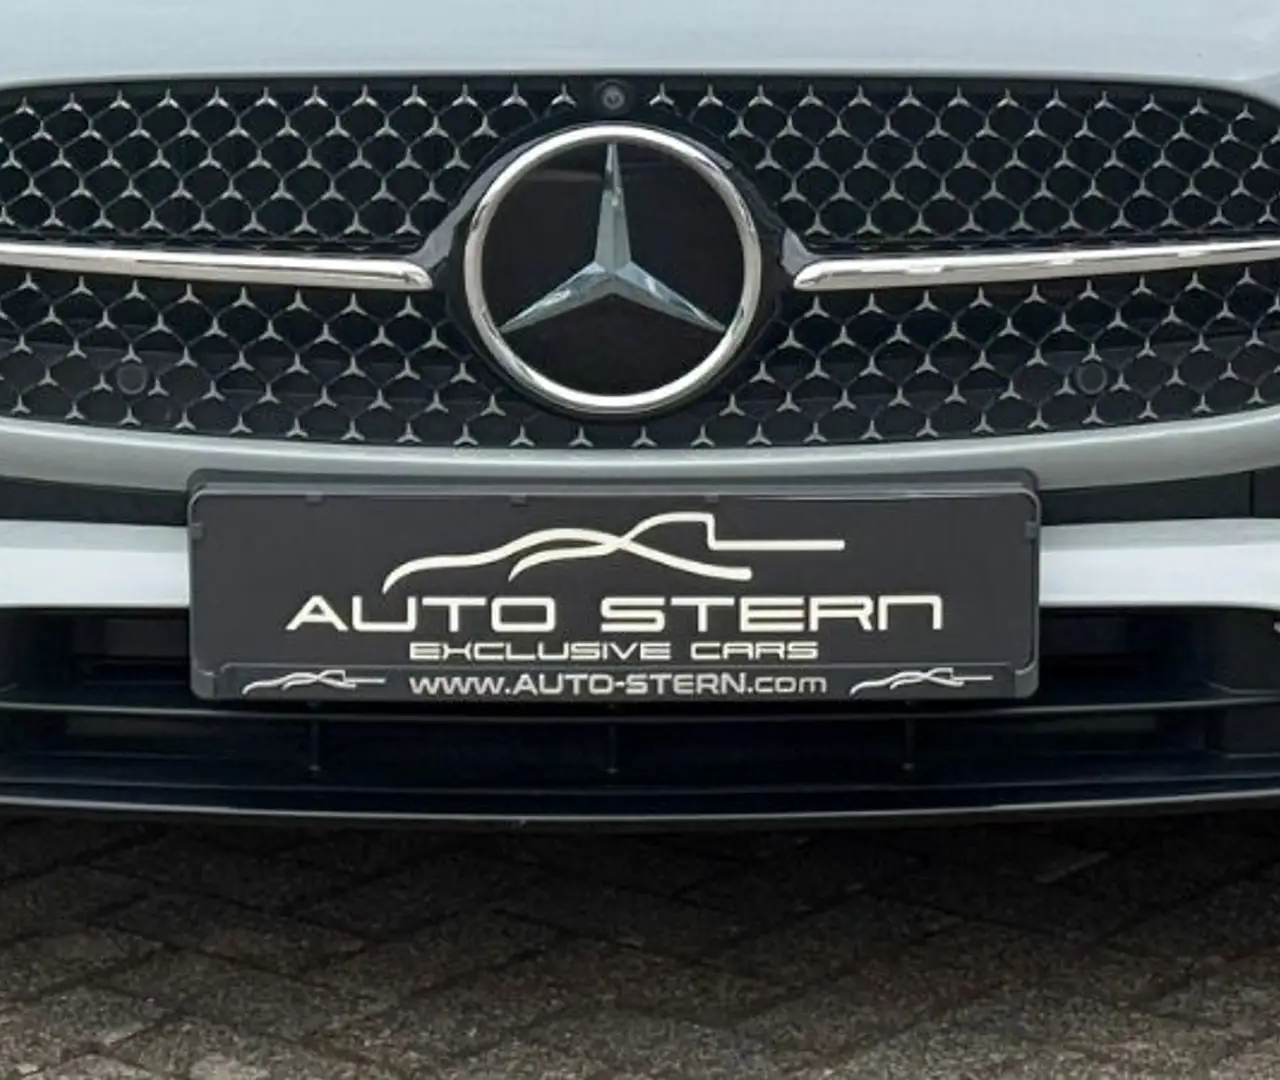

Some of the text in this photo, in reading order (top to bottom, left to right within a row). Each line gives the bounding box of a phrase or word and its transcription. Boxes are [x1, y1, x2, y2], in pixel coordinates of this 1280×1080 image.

[286, 595, 942, 632] AUTO STERN
[410, 642, 818, 660] EXCLUSIVE CARS
